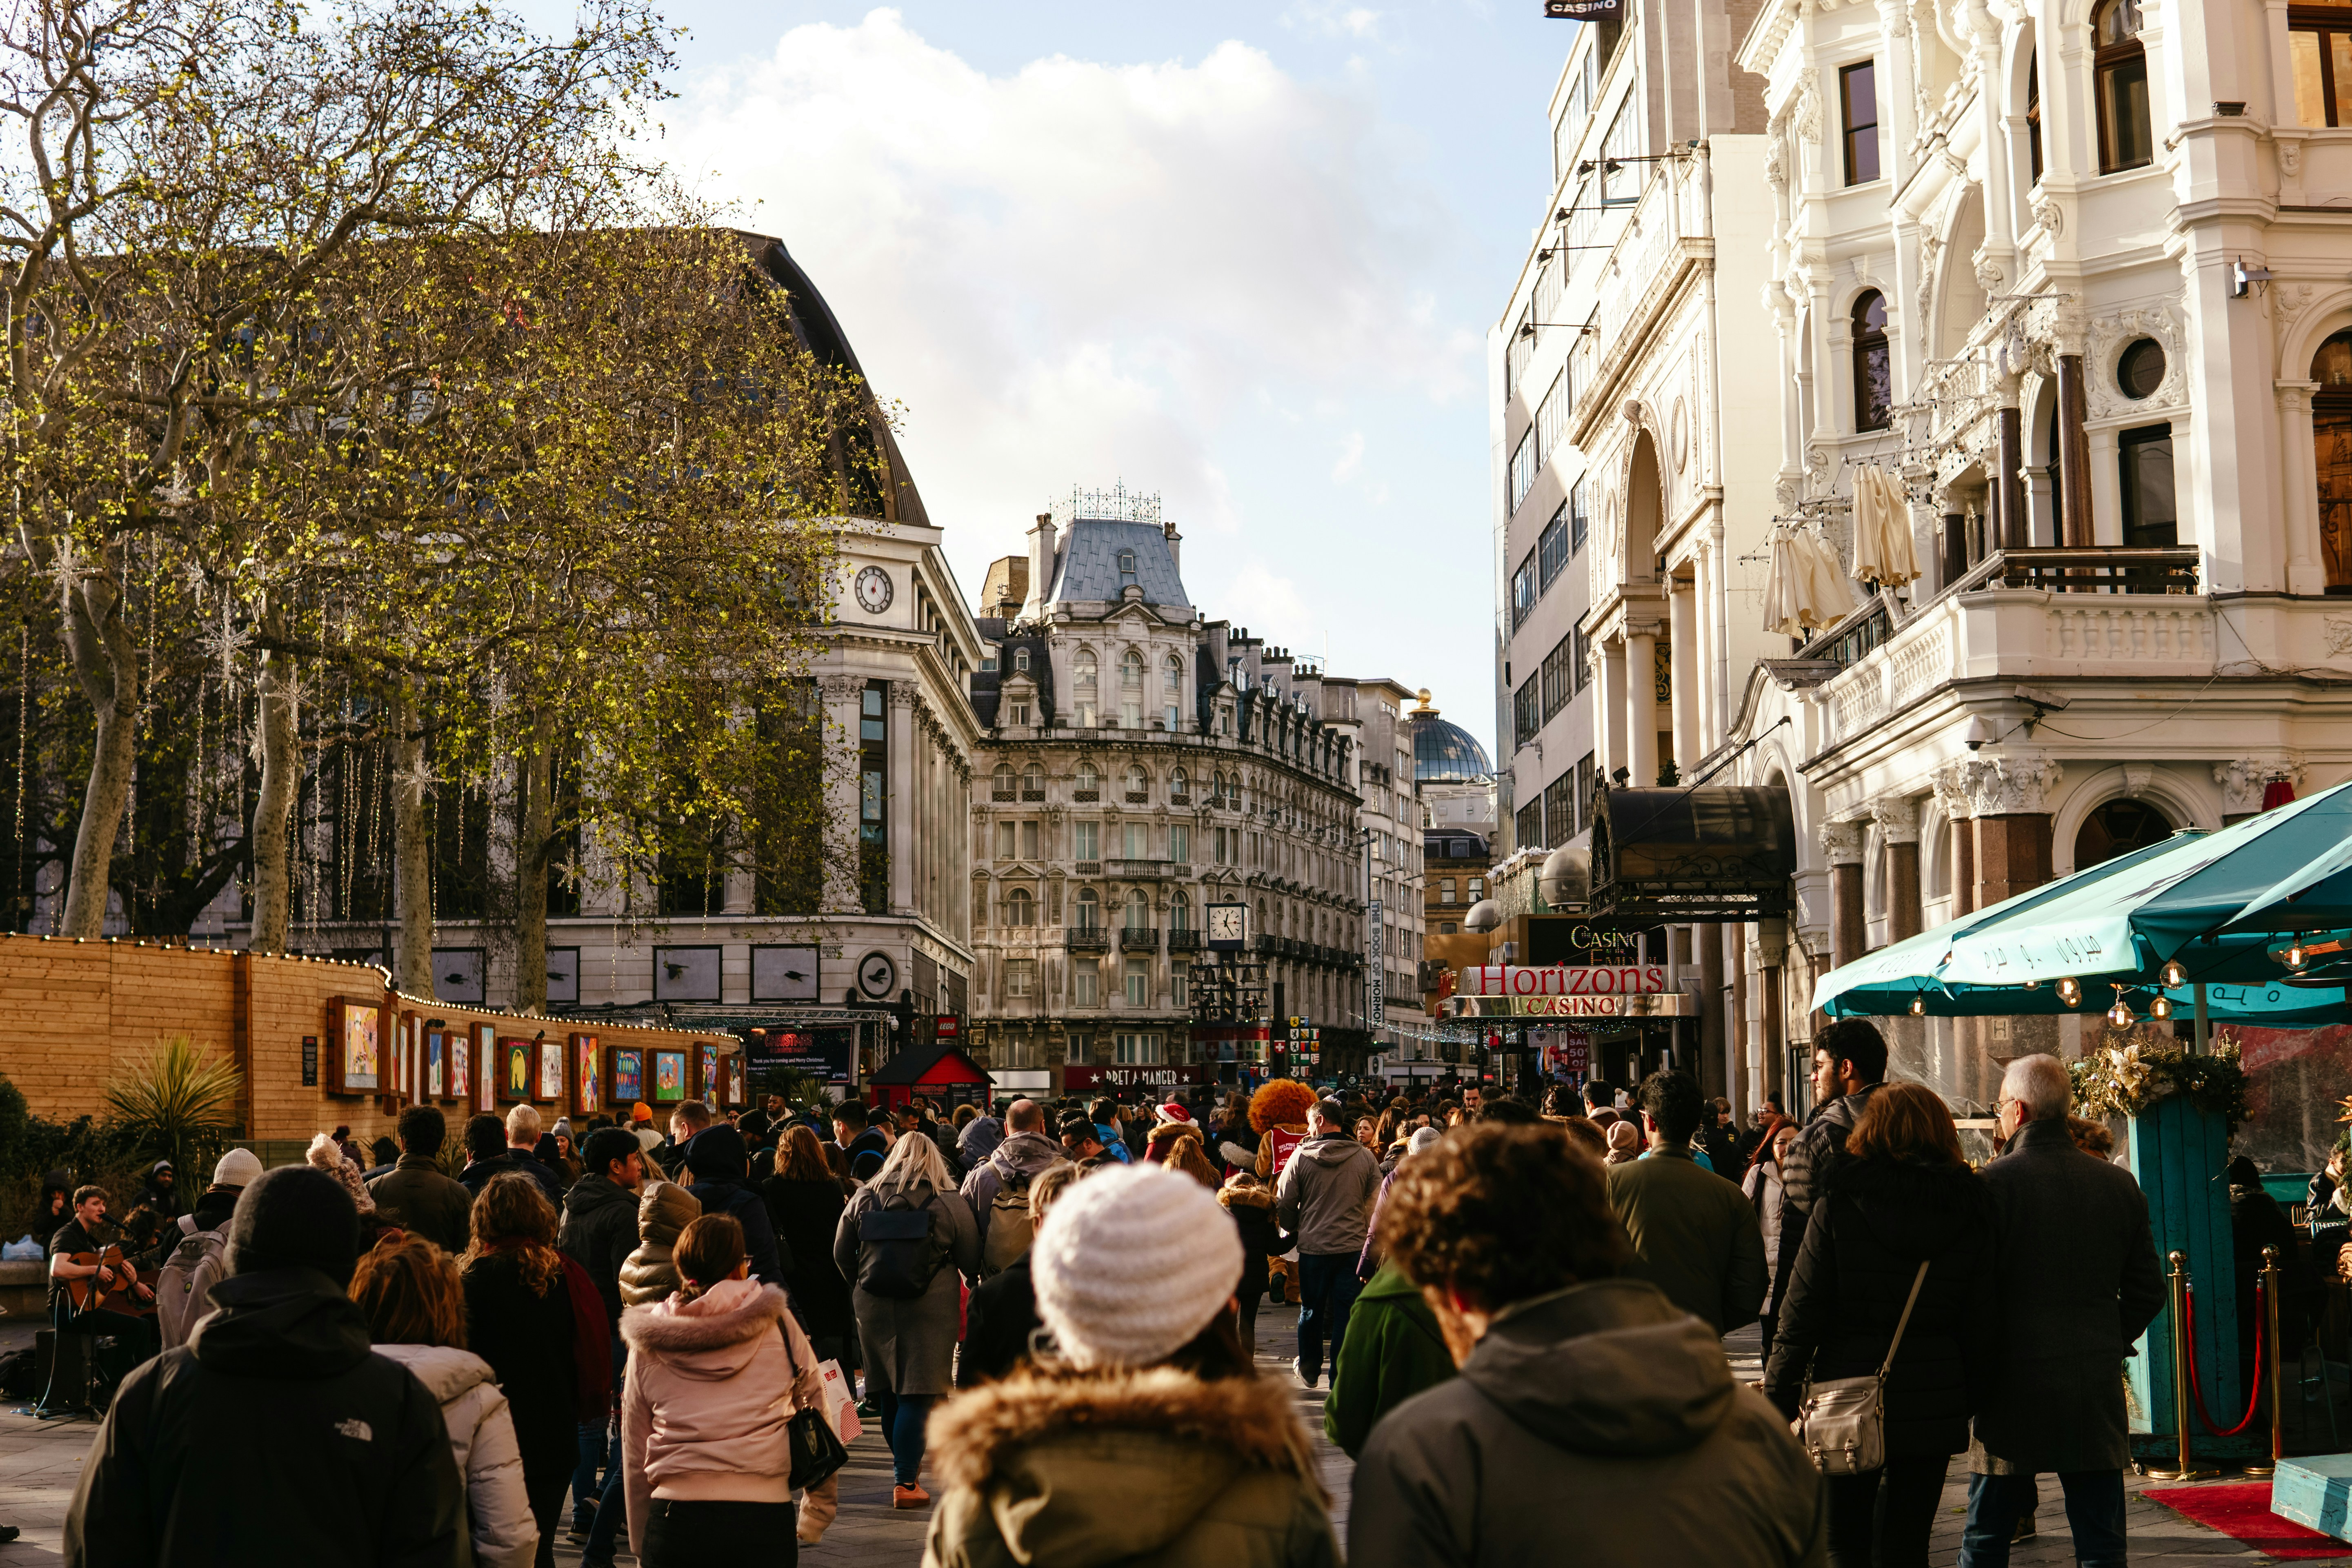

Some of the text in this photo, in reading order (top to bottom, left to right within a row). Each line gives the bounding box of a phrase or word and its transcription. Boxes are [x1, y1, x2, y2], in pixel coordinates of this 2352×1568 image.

[1551, 0, 1617, 13] CASINO
[1372, 927, 1381, 958] BOOK
[1373, 962, 1381, 976] OF
[1479, 961, 1663, 995] Horizons
[1527, 998, 1615, 1014] CASINO
[765, 1034, 813, 1047] CHRISTMAS
[1569, 1048, 1588, 1057] 50
[1106, 1070, 1129, 1085] PRET
[1143, 1070, 1177, 1085] MANGER
